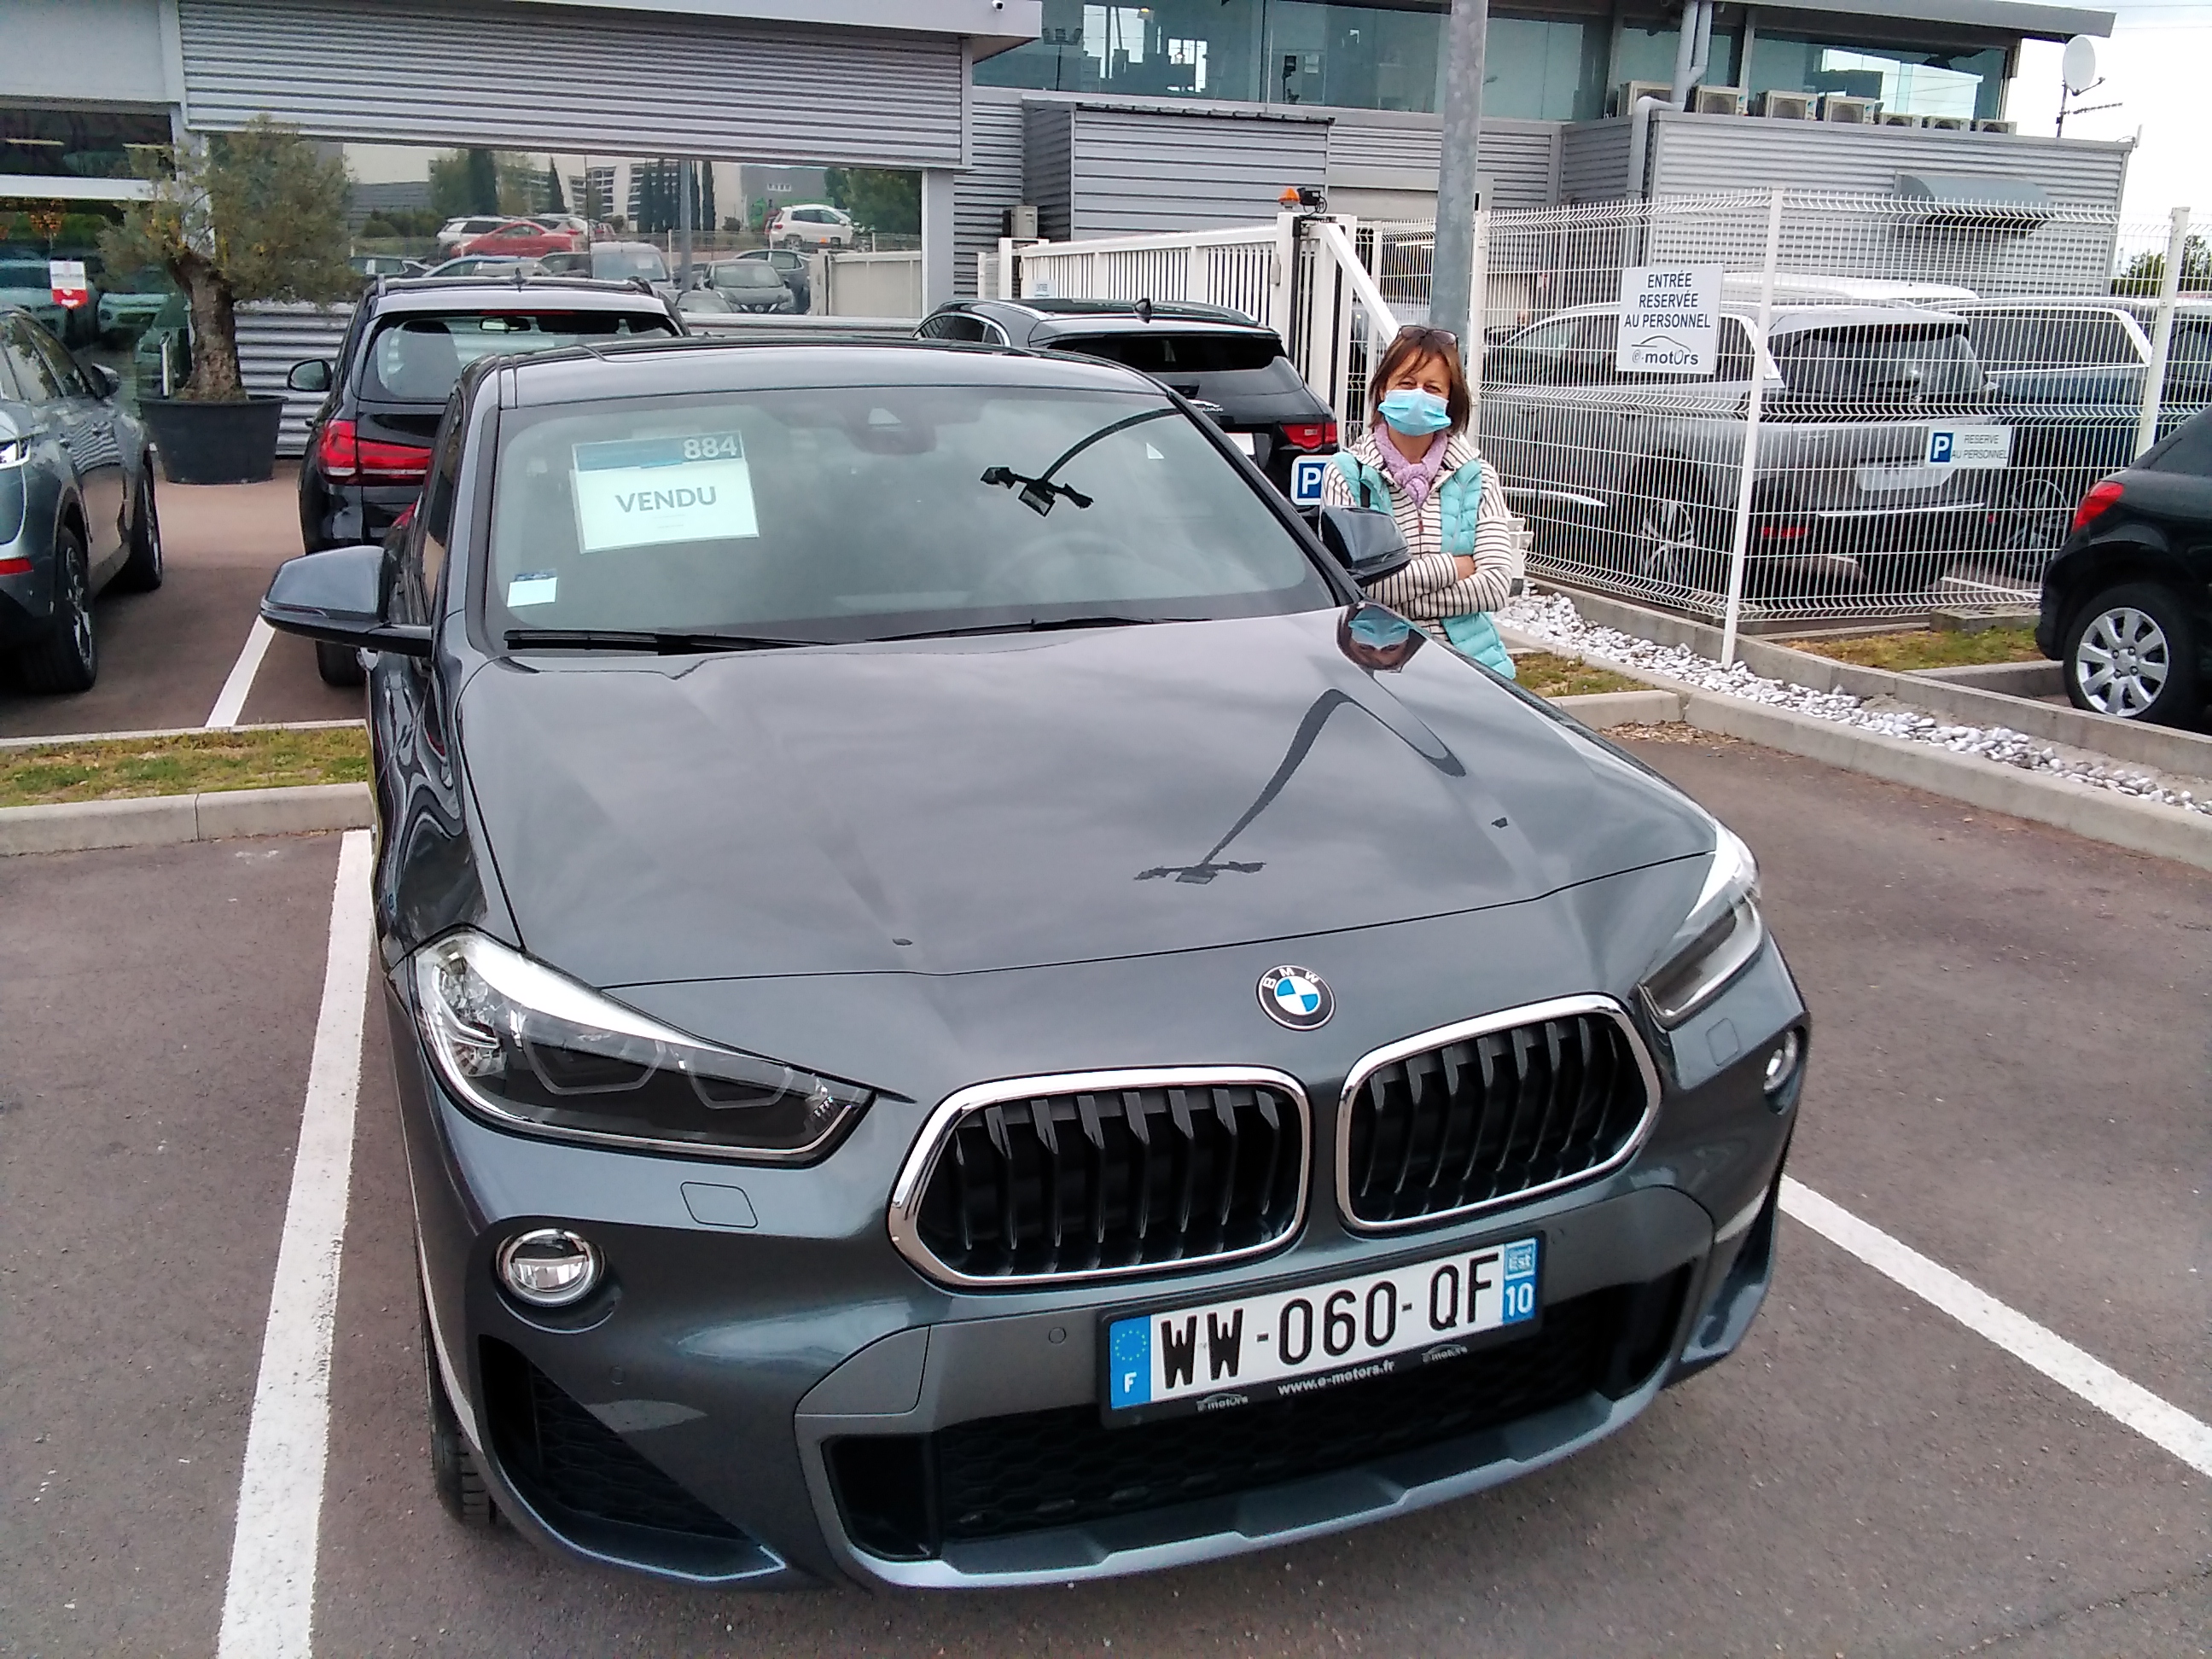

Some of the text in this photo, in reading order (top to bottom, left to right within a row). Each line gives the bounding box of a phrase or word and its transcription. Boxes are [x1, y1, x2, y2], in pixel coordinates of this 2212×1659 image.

[1647, 271, 1692, 288] ENTRÉE
[1639, 290, 1699, 308] RESERVÉE
[1624, 313, 1711, 328] AU PERSONNEL
[683, 436, 737, 460] 884
[1933, 436, 1950, 459] P
[1951, 449, 2007, 459] AU PERSONNEL
[1301, 467, 1322, 495] P
[615, 486, 718, 513] VENDU
[1262, 967, 1319, 989] BMW
[1505, 1282, 1534, 1317] 10
[1160, 1252, 1499, 1390] WW-060-QF
[1124, 1371, 1138, 1394] F
[1277, 1359, 1395, 1395] www.e-motors.fr
